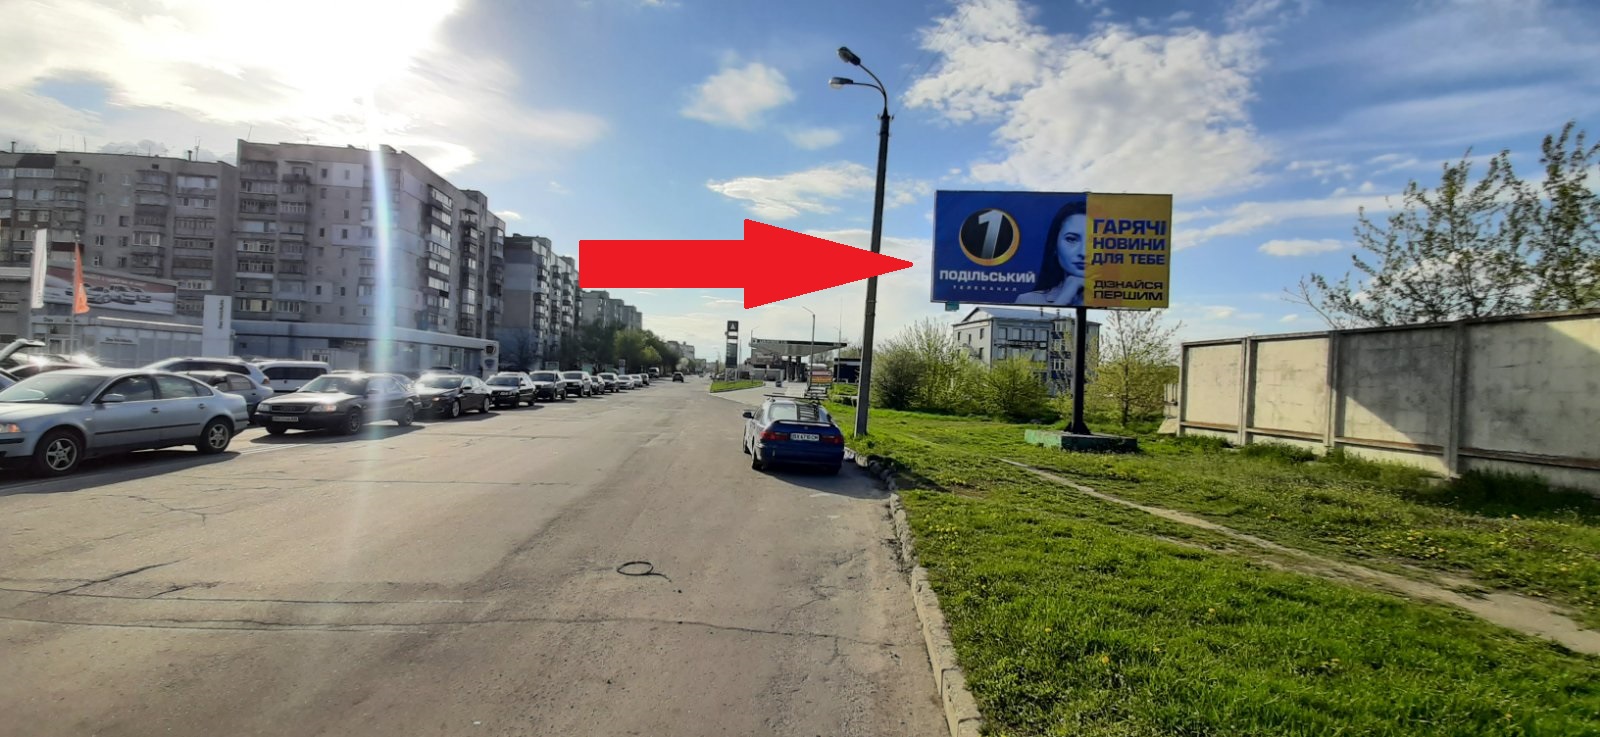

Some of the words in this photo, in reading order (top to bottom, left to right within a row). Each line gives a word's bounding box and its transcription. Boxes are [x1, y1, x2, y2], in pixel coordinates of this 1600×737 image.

[1092, 218, 1166, 235] ГАРЯЧІ
[978, 209, 1004, 259] 1
[1092, 237, 1166, 251] НОВИНИ
[1091, 252, 1124, 266] ДЛЯ
[1129, 254, 1165, 265] ТЕБЕ
[939, 269, 1036, 283] ПОДІЛЬСЬКИЙ
[953, 284, 1018, 292] ТЕЛЕКАНАЛ
[1094, 280, 1163, 290] ДІЗНАЙСЯ
[1093, 290, 1163, 301] ПЕРШИМ
